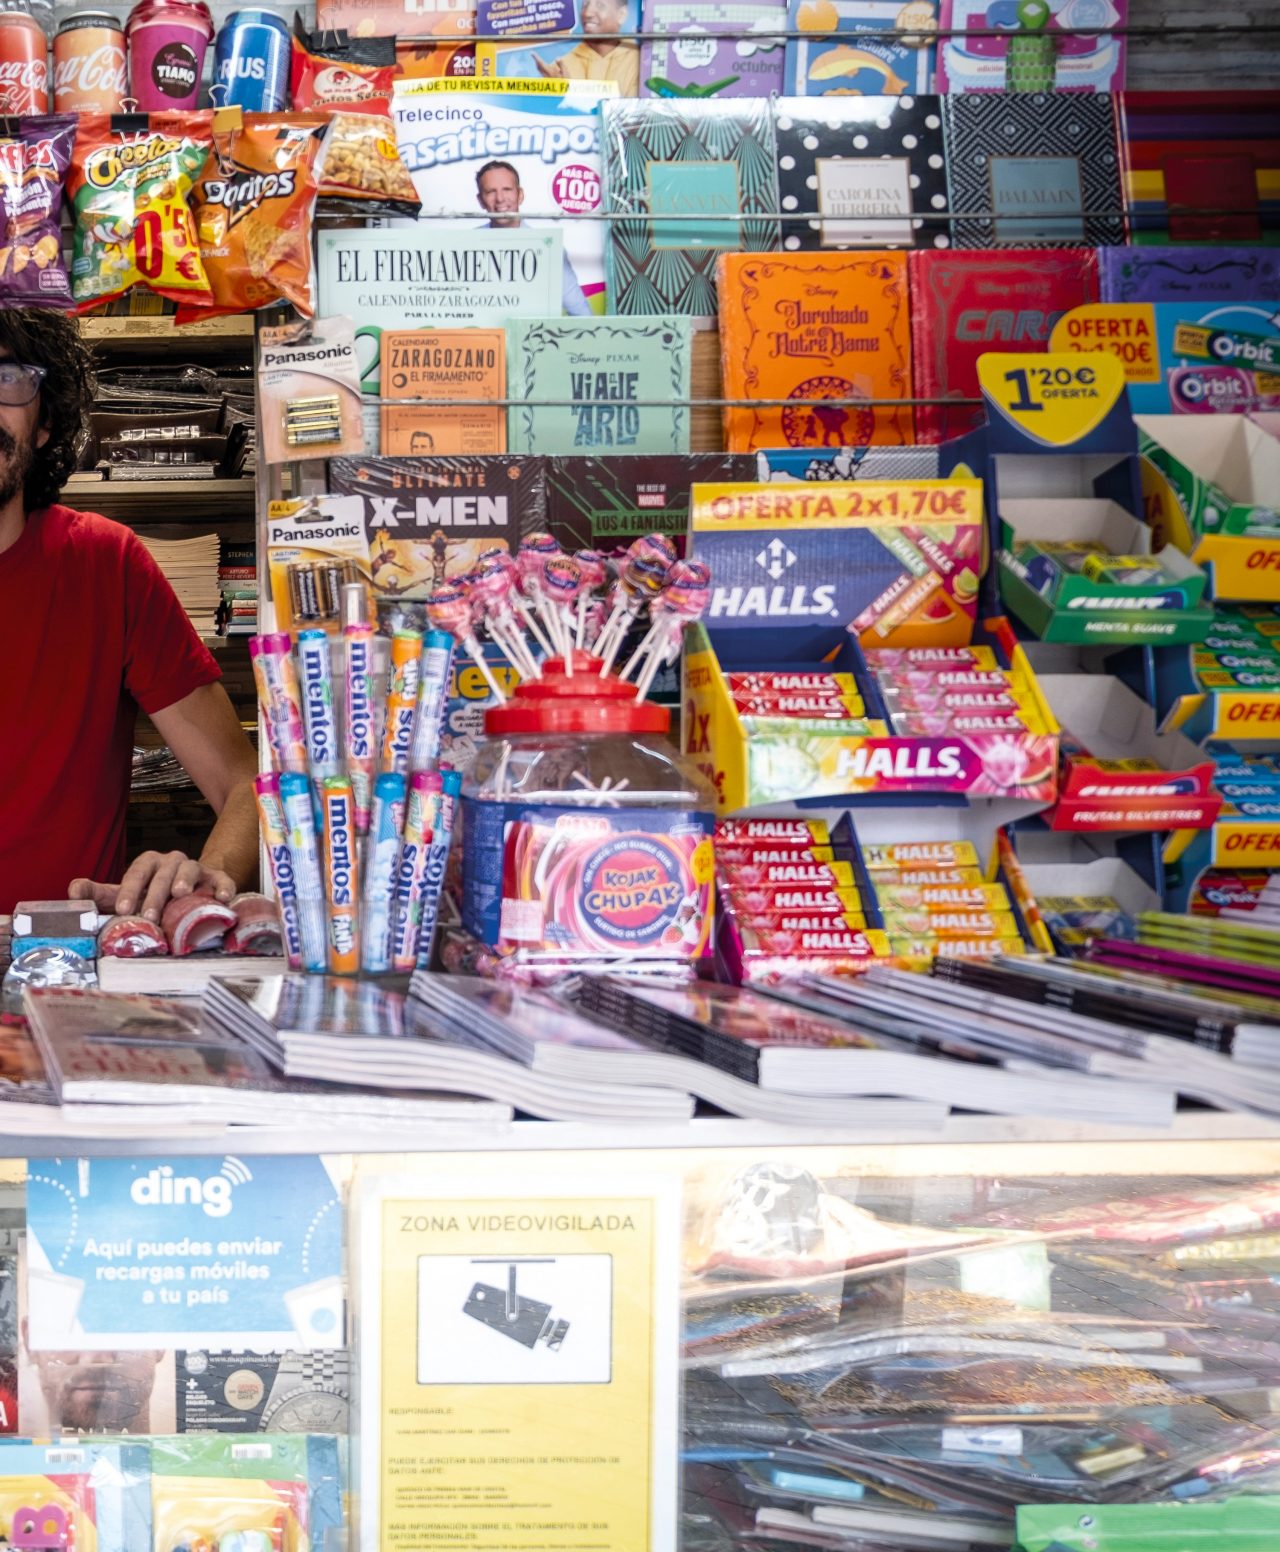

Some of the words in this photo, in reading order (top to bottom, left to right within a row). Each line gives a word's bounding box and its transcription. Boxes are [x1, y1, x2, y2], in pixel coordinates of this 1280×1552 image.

[156, 63, 196, 82] TIAMO
[731, 60, 781, 74] octubre
[427, 80, 440, 90] DE
[444, 80, 456, 90] TU
[461, 81, 505, 90] REVISTA
[508, 81, 556, 92] MENSUAL
[397, 107, 482, 123] Telecinco
[401, 122, 600, 169] asatiempo
[87, 135, 184, 190] Cheetos
[205, 172, 295, 209] Doritos
[555, 178, 600, 200] 100
[827, 186, 902, 202] CAROLINA
[999, 189, 1076, 203] BALMAIN
[831, 202, 902, 216] HERRERA
[336, 250, 368, 283] EL
[372, 248, 538, 283] FIRMAMENTO
[358, 294, 436, 307] CALENDARIO
[438, 294, 520, 307] ZARAGOZANO
[1067, 319, 1149, 337] OFERTA
[263, 343, 352, 368] Panasonic
[391, 349, 495, 369] ZARAGOZANO
[569, 353, 600, 366] Disney
[606, 354, 640, 362] PIXAR
[411, 372, 420, 382] EL
[422, 371, 483, 382] FIRMAMENTO
[1041, 388, 1098, 399] OFERTA
[1182, 376, 1242, 398] Orbit
[369, 495, 509, 527] X-MEN
[711, 495, 835, 520] OFERTA
[846, 490, 967, 518] 2x1,70€
[272, 522, 360, 542] Panasonic
[596, 517, 617, 531] LOS
[709, 584, 835, 617] HALLS
[1084, 622, 1131, 632] MENTA
[1132, 622, 1176, 634] SUAVE
[304, 650, 329, 764] mentos
[836, 746, 961, 780] HALLS
[1073, 811, 1123, 822] FRUTAS
[1126, 809, 1202, 821] SILVESTRES
[748, 821, 808, 837] HALLS
[330, 798, 350, 905] mentos
[893, 844, 956, 861] HALLS
[604, 868, 657, 886] KOJAK
[131, 1166, 233, 1218] ding
[400, 1216, 460, 1232] ZONA
[468, 1214, 635, 1231] VIDEOVIGILADA
[83, 1238, 132, 1258] Aquí
[137, 1240, 213, 1259] puedes
[217, 1238, 282, 1256] enviar
[96, 1264, 186, 1284] recargas
[190, 1261, 270, 1279] móviles
[142, 1291, 155, 1303] a
[159, 1288, 181, 1303] tu
[187, 1286, 229, 1306] país
